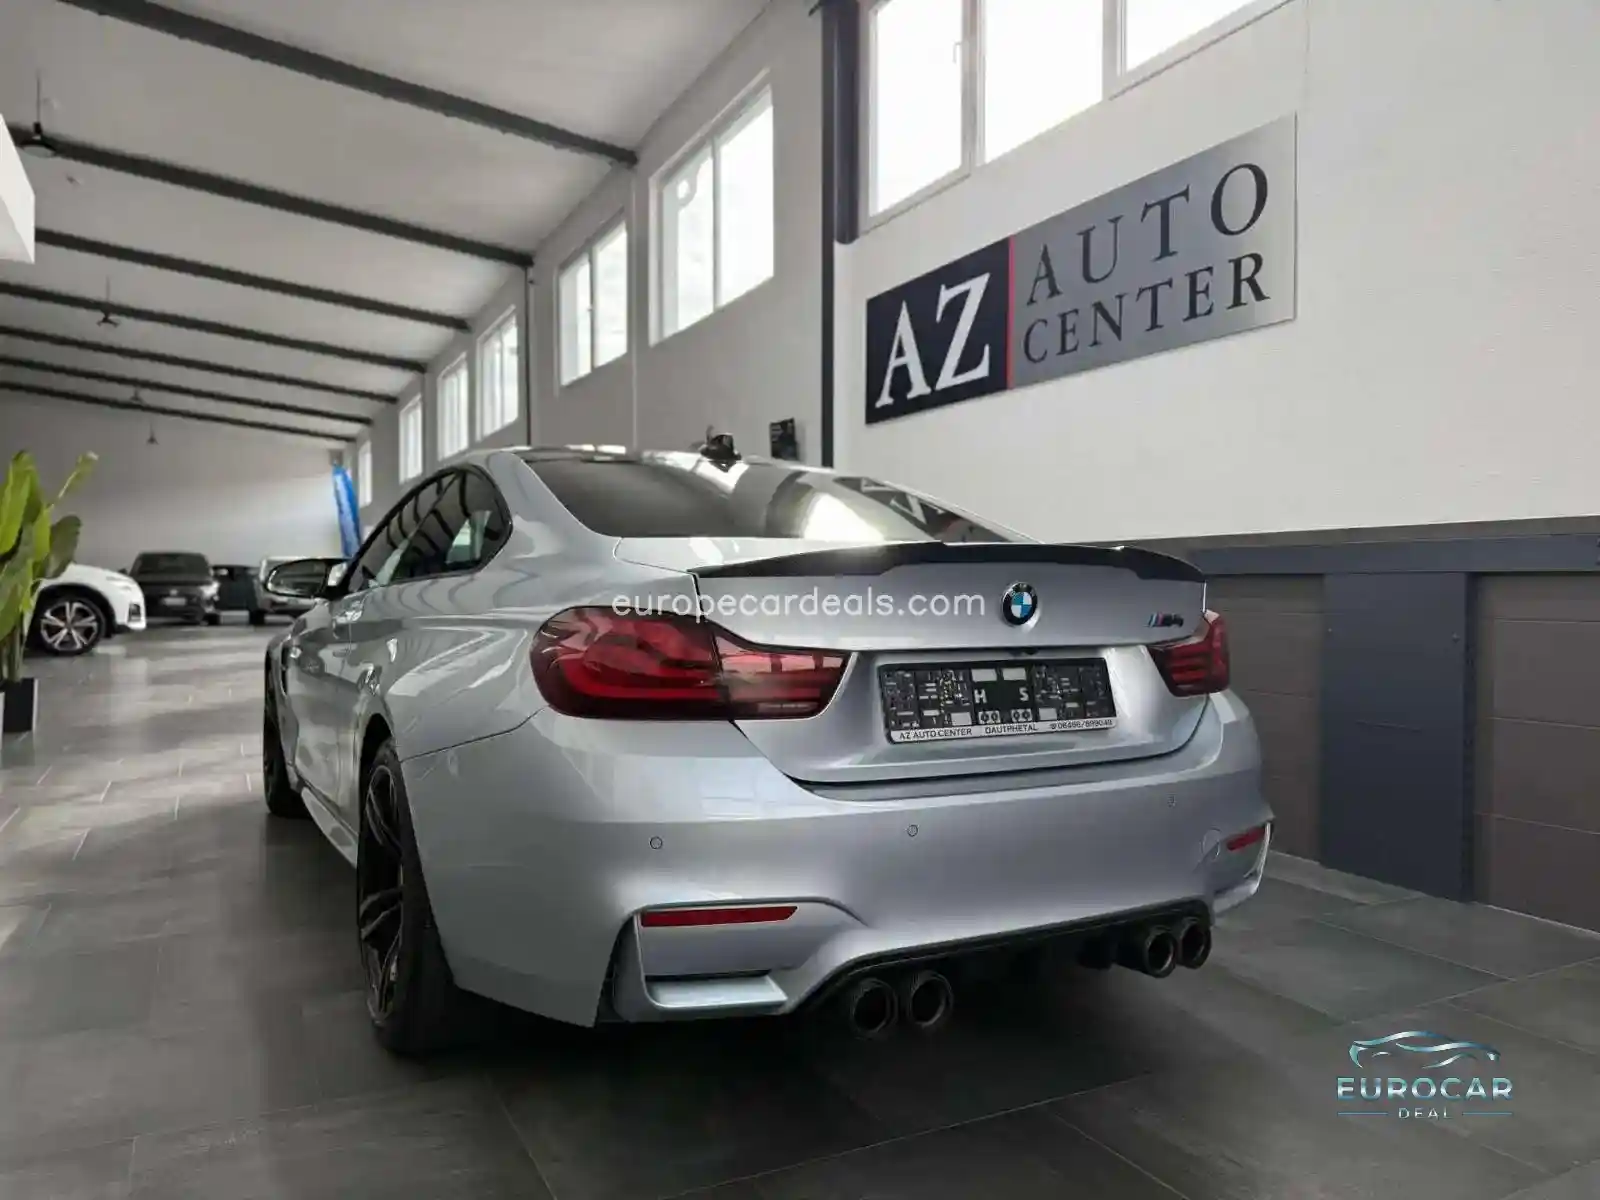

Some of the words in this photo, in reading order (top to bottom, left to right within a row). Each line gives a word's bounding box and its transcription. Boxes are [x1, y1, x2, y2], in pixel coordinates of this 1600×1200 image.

[1026, 162, 1268, 307] AUTO
[875, 272, 990, 409] AZ
[1023, 252, 1270, 364] CENTER
[914, 730, 937, 739] AUTO
[938, 728, 972, 737] CENTER
[985, 724, 1038, 734] DAUTPHETAL
